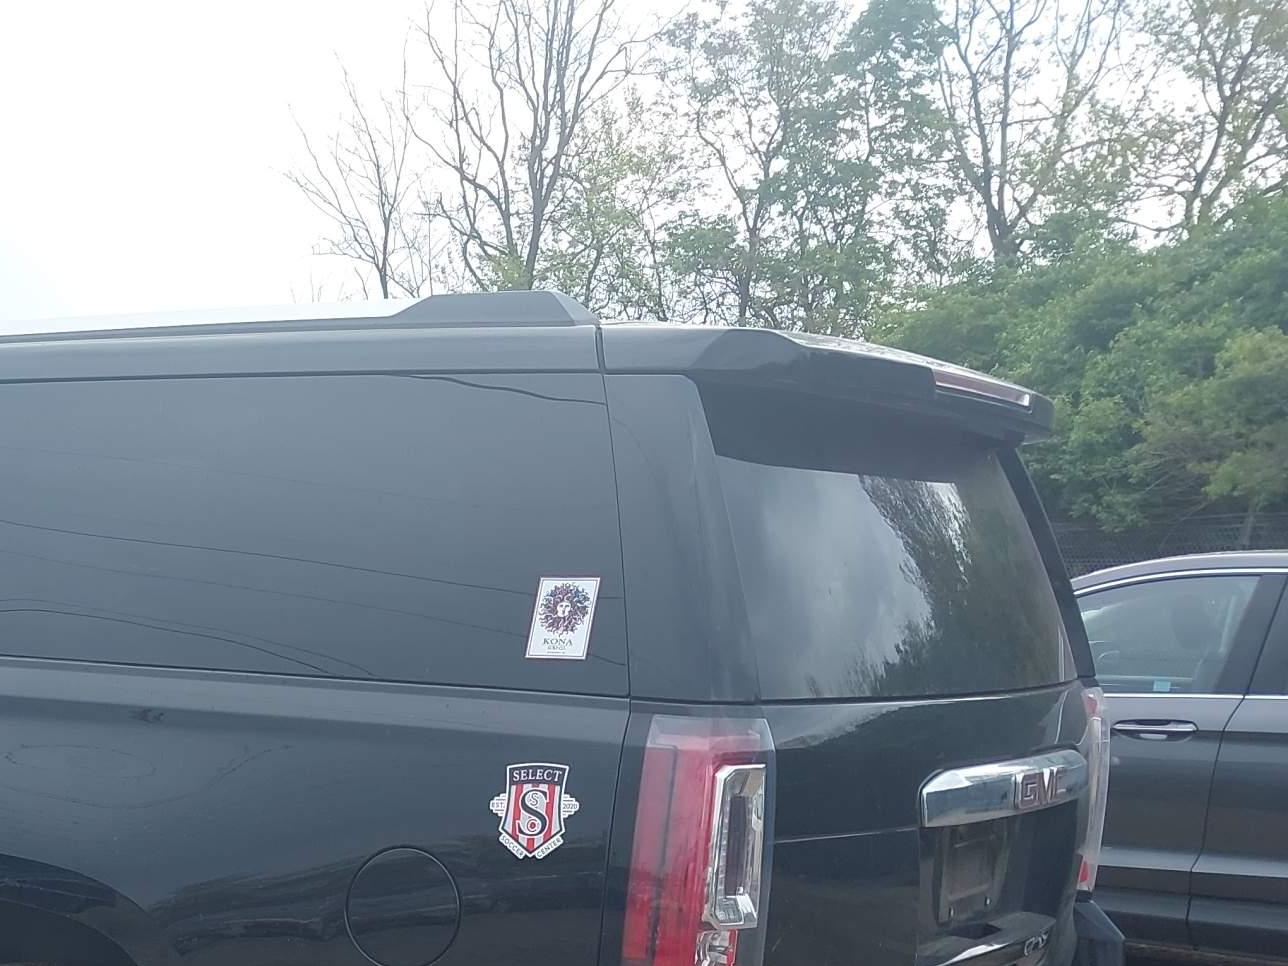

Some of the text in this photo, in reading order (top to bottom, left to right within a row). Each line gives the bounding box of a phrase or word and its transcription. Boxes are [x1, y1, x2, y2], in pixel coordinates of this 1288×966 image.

[512, 768, 563, 782] SELECT
[1017, 767, 1067, 807] GMC
[562, 802, 578, 810] 2020
[501, 836, 524, 857] SOCCER
[536, 837, 562, 858] CENTER
